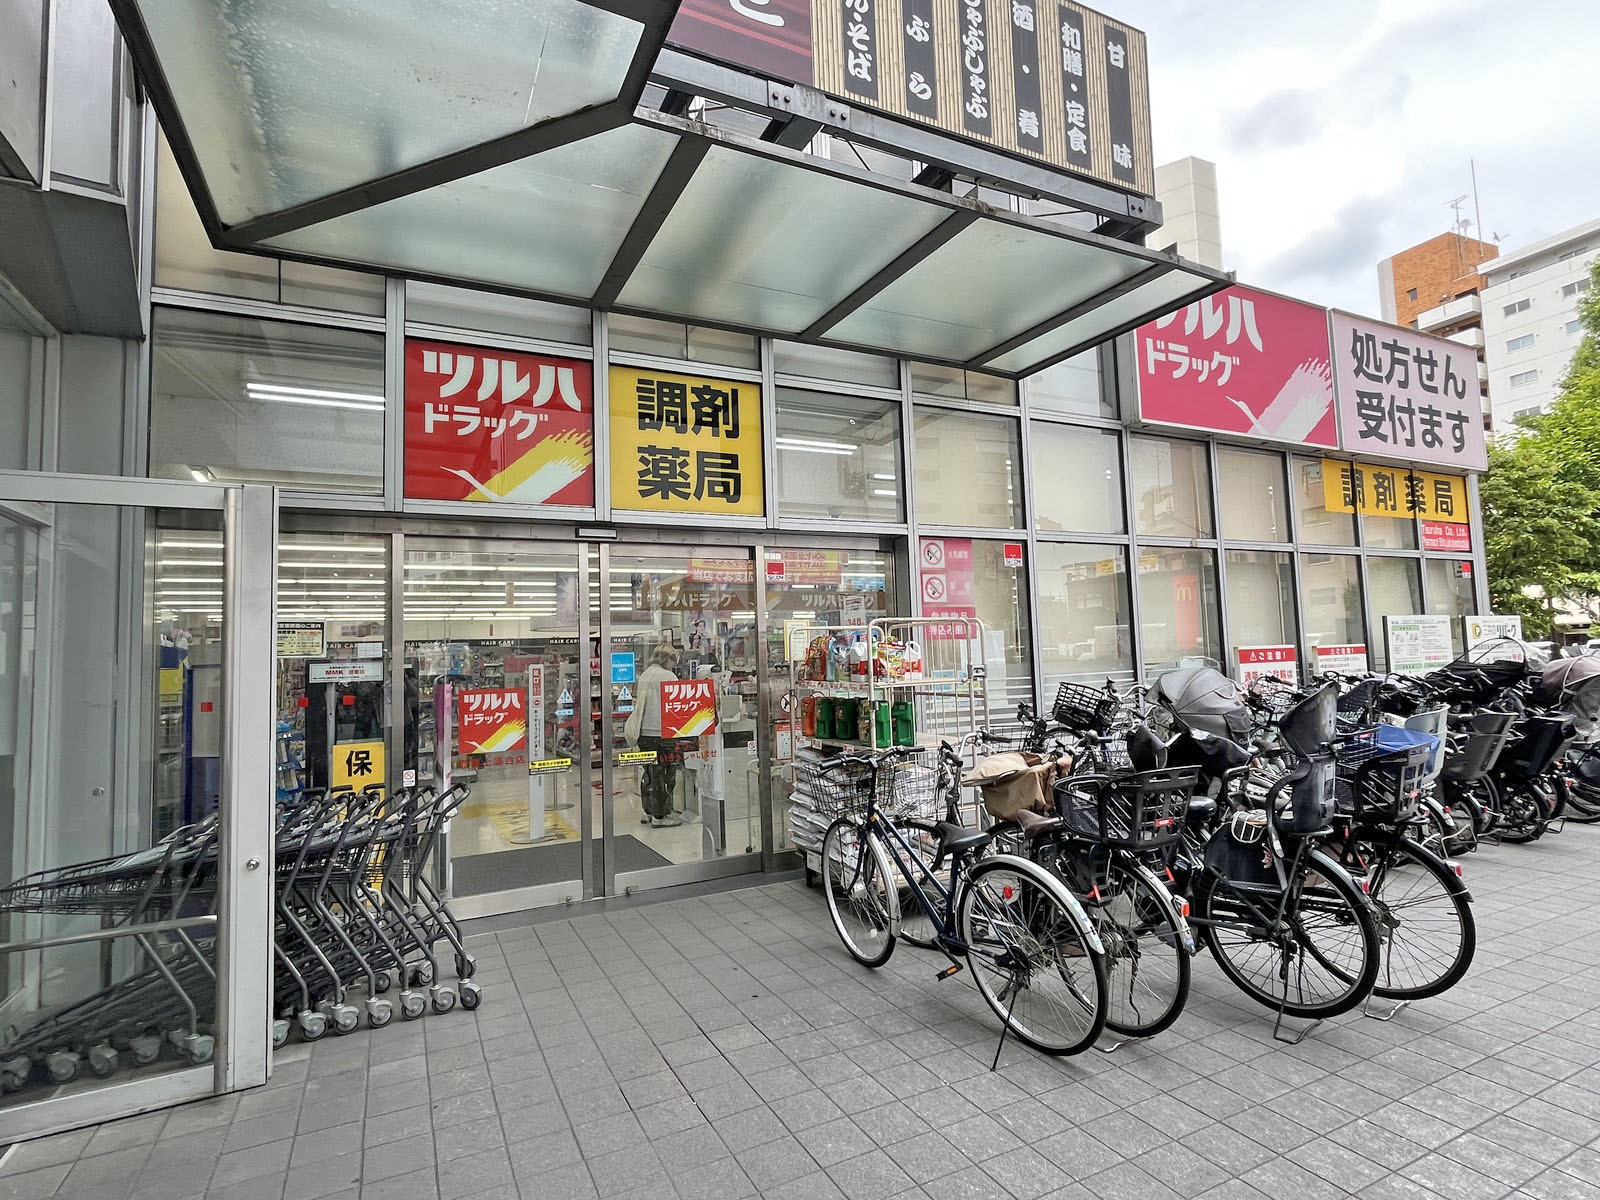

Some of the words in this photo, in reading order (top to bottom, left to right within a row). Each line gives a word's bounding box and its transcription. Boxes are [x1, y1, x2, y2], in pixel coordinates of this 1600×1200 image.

[962, 0, 988, 119] ゃぶしゃぶ
[1107, 41, 1132, 169] 甘味
[422, 350, 581, 412] ツルハ
[1145, 337, 1240, 387] ドラッグ
[1350, 328, 1466, 400] 処方せん
[424, 402, 549, 441] ドラッグ
[636, 378, 740, 440] 調剤
[1356, 390, 1470, 453] 受付ます
[637, 445, 742, 504] 薬局
[1340, 468, 1455, 518] 調剤薬局
[464, 692, 521, 712] ツルハ
[664, 683, 711, 700] ツルハ
[665, 700, 702, 713] ドラッグ
[463, 711, 508, 726] ドラッグ
[345, 750, 374, 777] 保
